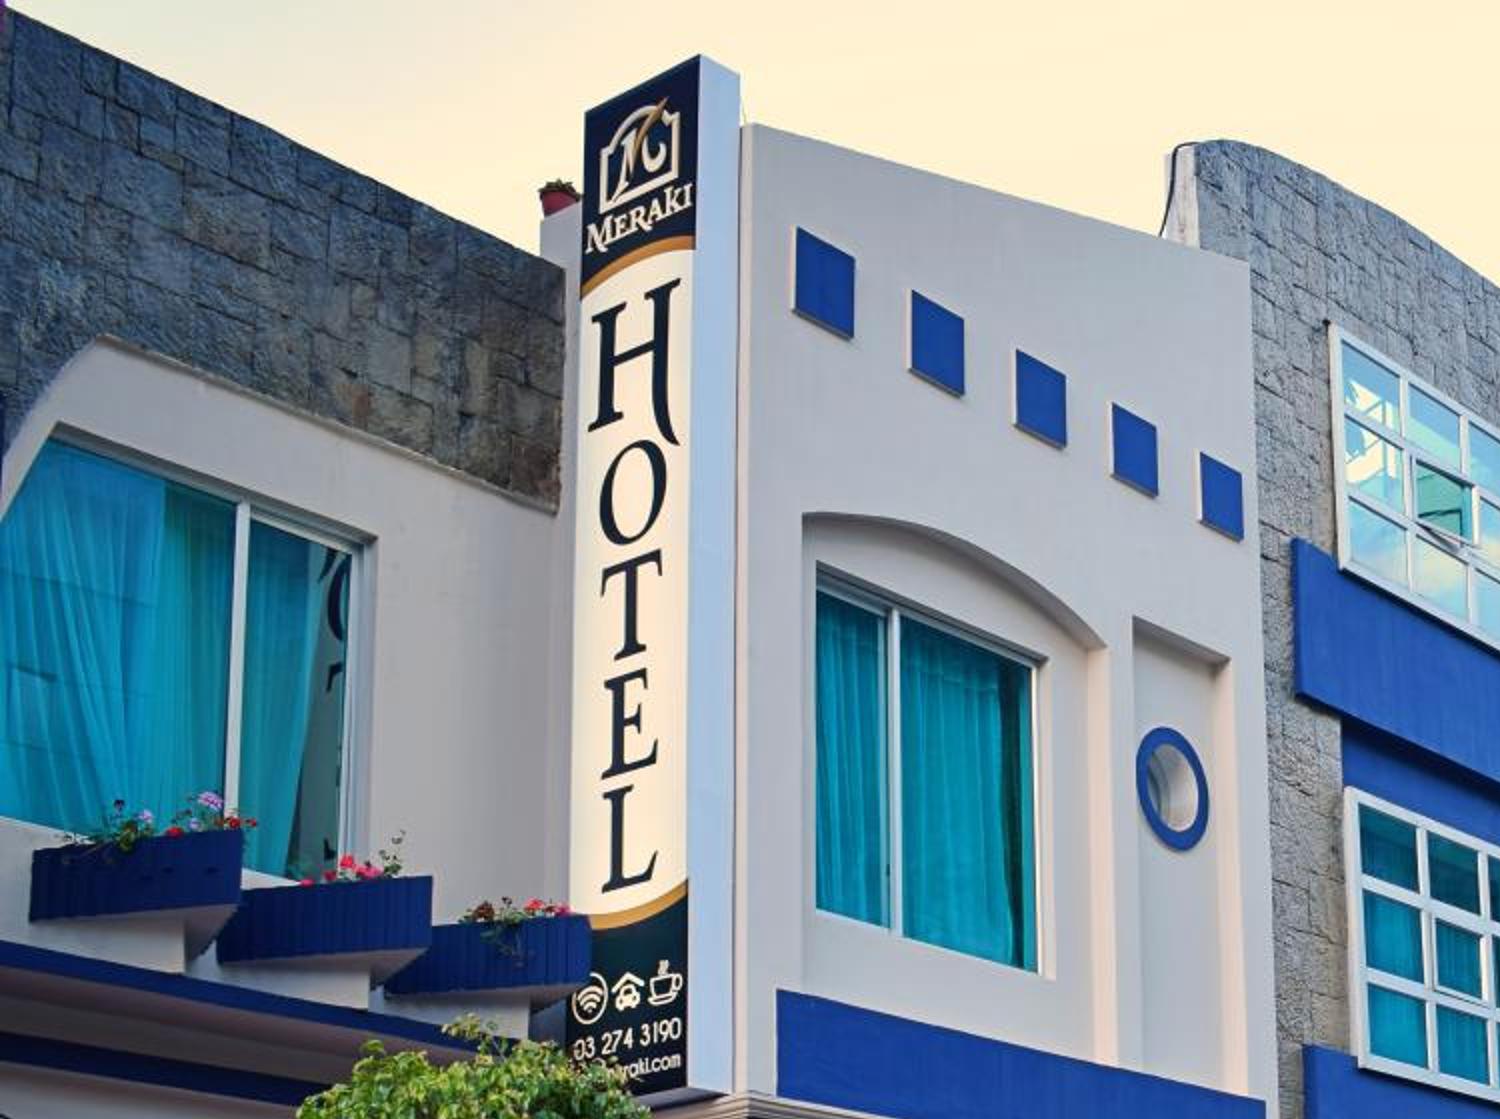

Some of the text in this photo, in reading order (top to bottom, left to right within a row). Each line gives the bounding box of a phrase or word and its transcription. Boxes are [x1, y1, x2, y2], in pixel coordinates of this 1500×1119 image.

[585, 183, 693, 254] MERAKI
[587, 278, 681, 893] HOTEL
[573, 1017, 682, 1060] 03 274 3190
